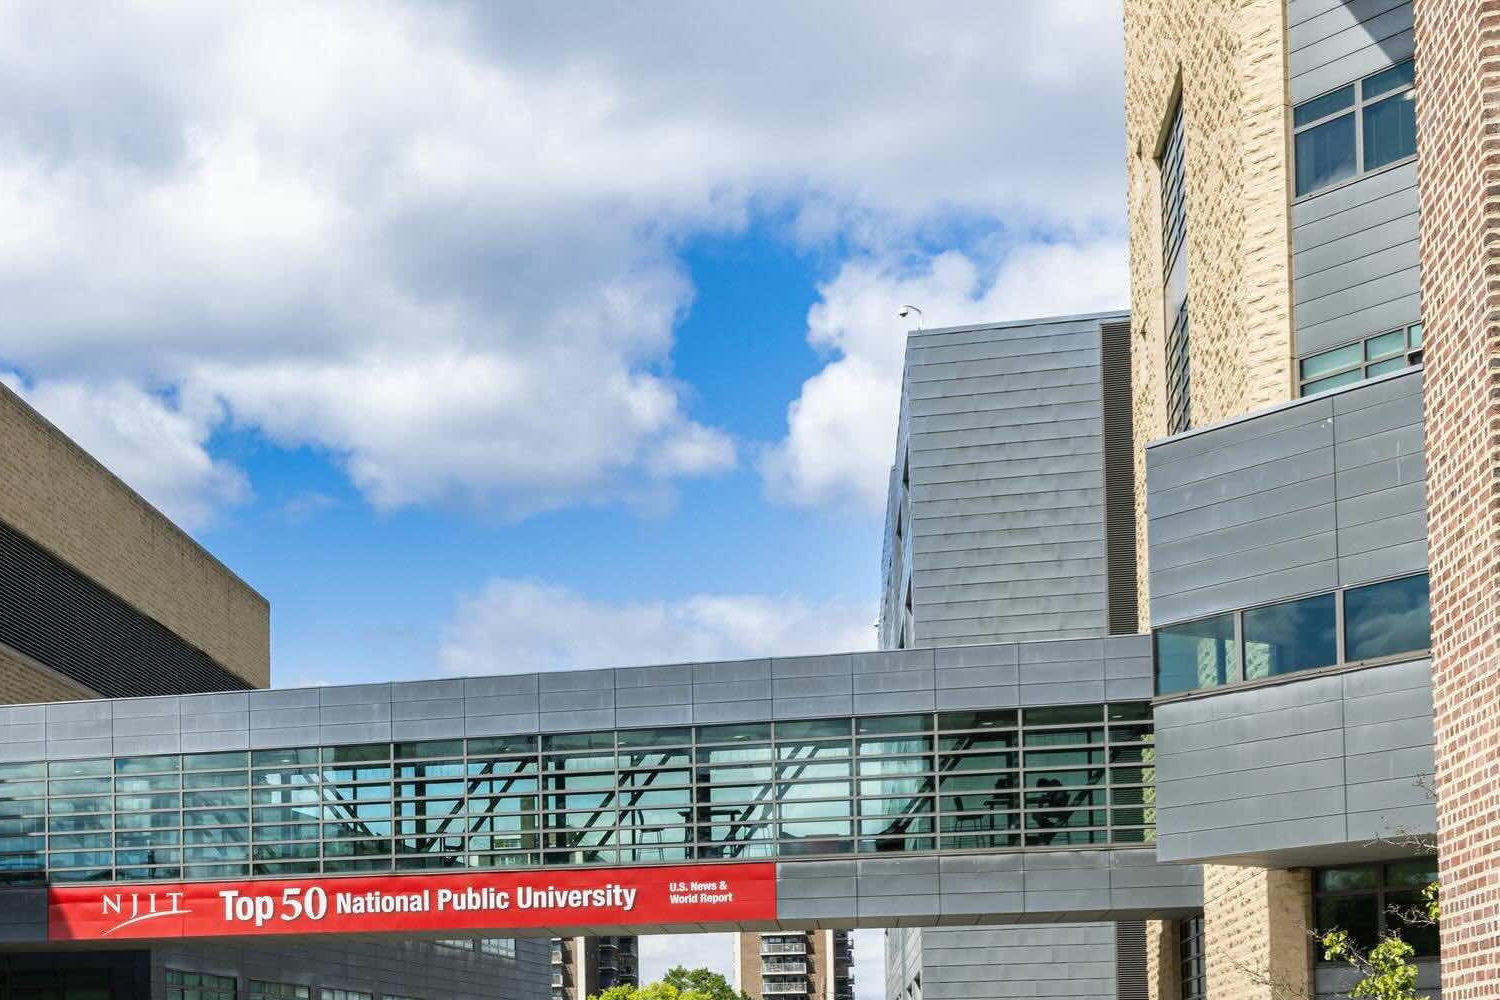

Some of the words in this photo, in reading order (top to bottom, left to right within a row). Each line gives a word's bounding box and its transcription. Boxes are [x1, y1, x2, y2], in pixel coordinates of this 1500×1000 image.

[669, 882, 689, 892] U.S.
[690, 881, 717, 891] News
[719, 880, 728, 890] &
[669, 893, 698, 904] World
[700, 892, 733, 905] Report
[102, 892, 184, 919] NJIT
[219, 890, 275, 927] Top
[280, 886, 328, 921] 50
[336, 889, 430, 914] National
[437, 887, 511, 911] Public
[517, 884, 637, 911] University
